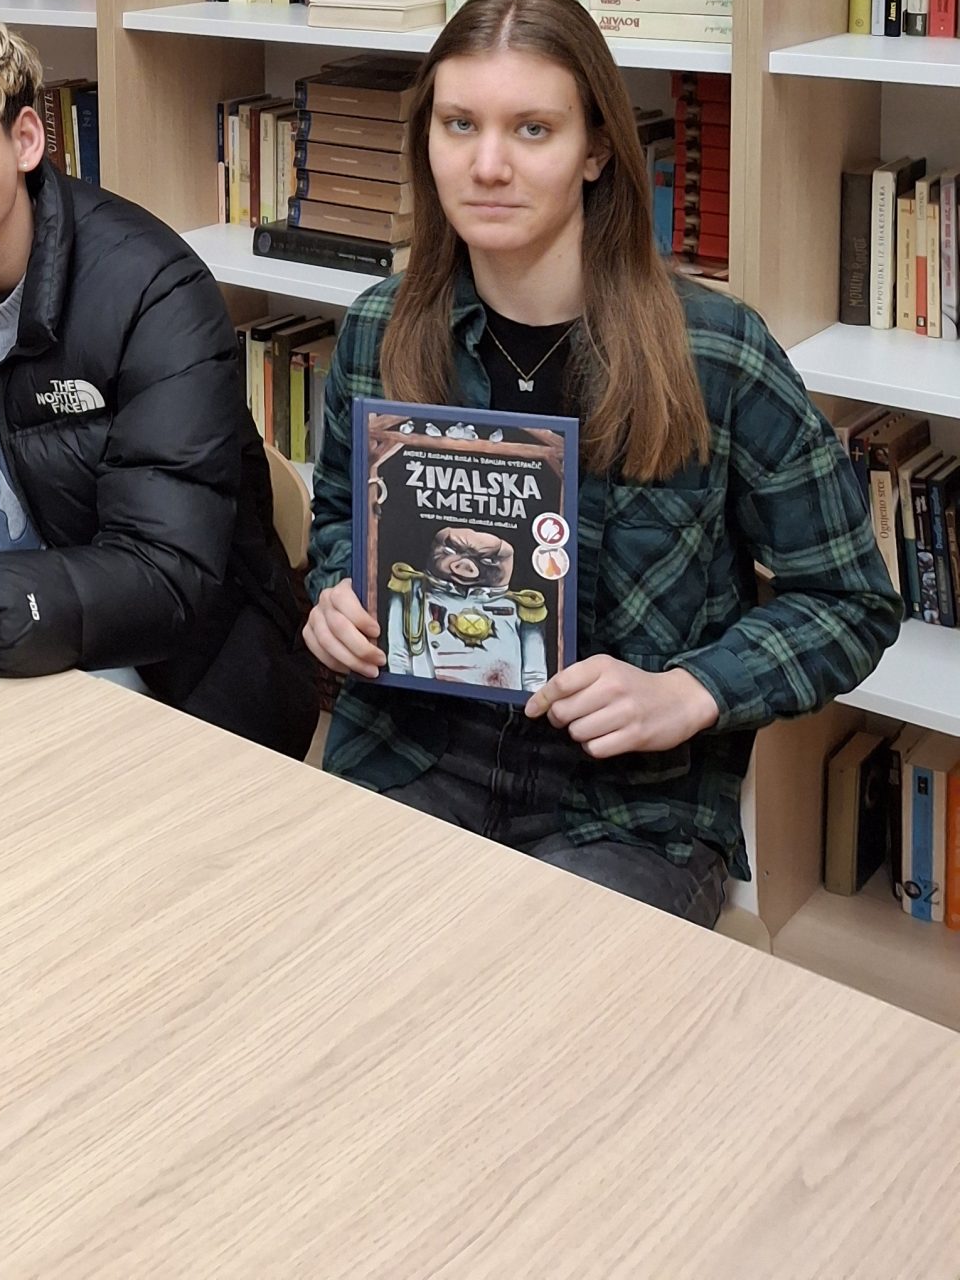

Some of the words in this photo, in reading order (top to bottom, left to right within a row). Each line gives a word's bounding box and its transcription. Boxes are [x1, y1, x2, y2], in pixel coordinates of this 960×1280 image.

[600, 17, 640, 27] BOVARY
[888, 2, 897, 21] James
[877, 185, 885, 246] SHAKESPEARA
[878, 249, 884, 258] IZ
[849, 272, 865, 306] MOULIN
[877, 263, 885, 316] PRIPOVEDKE
[50, 379, 76, 392] THE
[36, 391, 79, 405] NORTH
[51, 403, 84, 414] FACE
[405, 460, 542, 501] ŽIVALSKA
[877, 479, 885, 497] srce
[416, 488, 527, 519] KMETIJA
[878, 500, 891, 539] Ognjeno
[26, 593, 40, 621] 700
